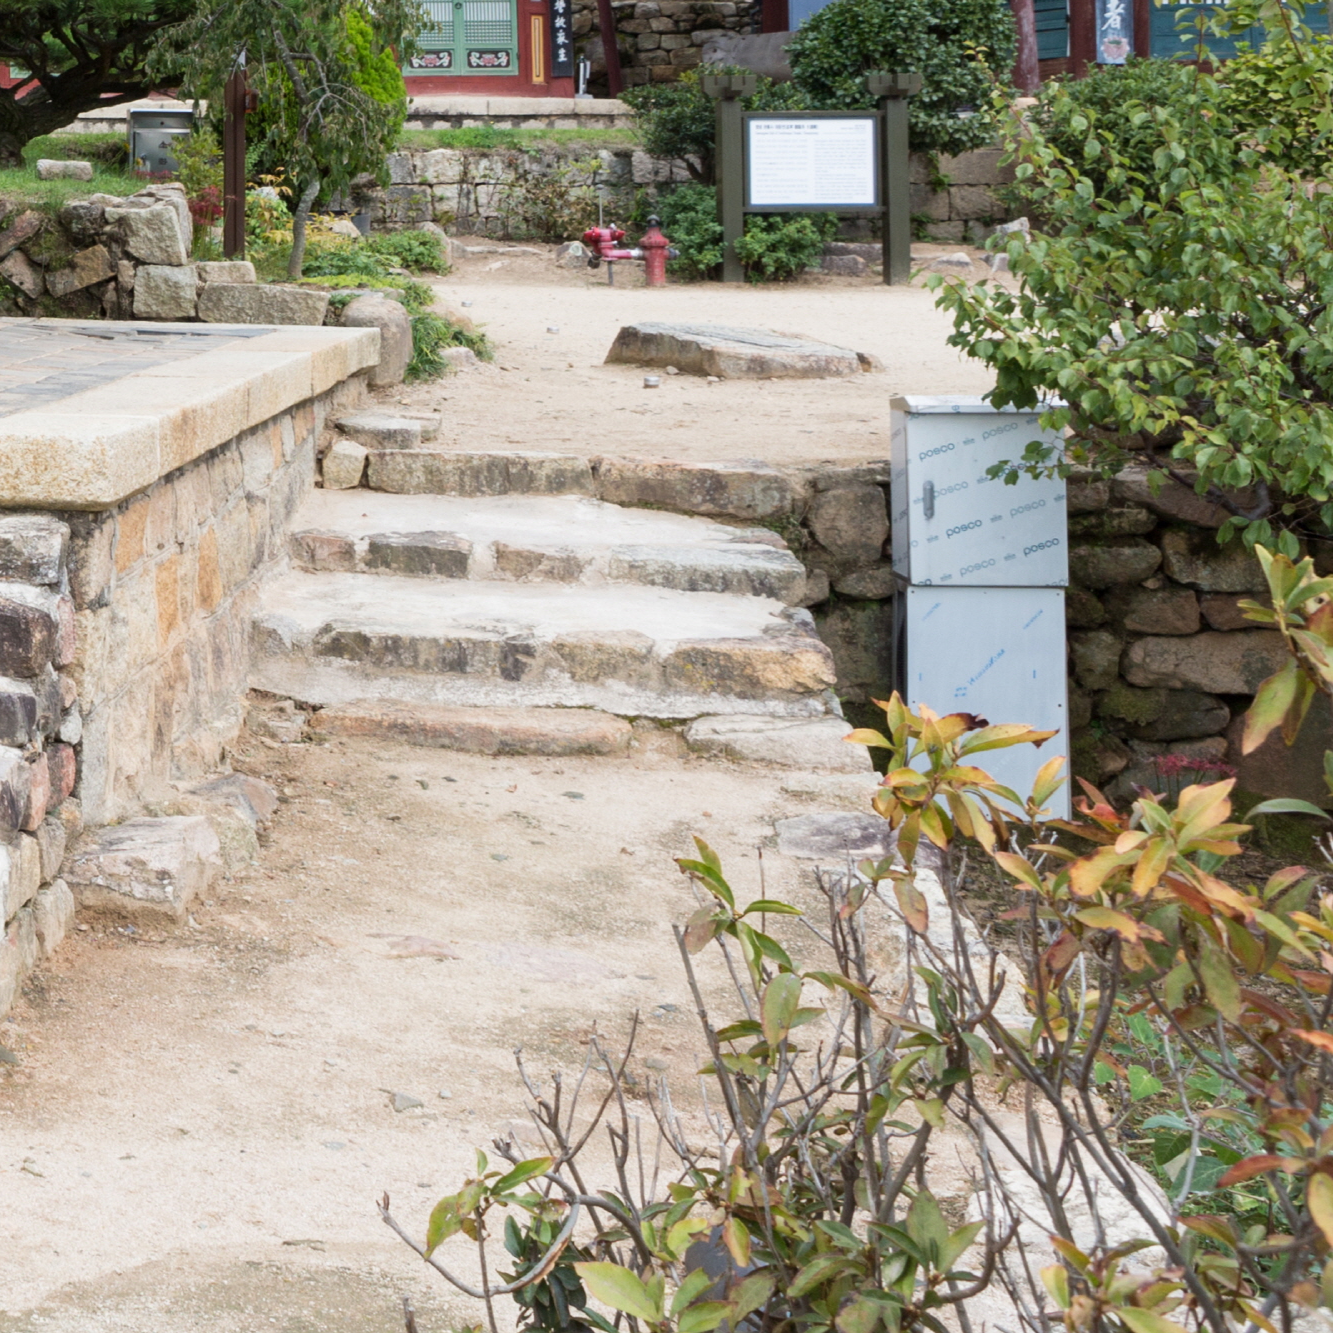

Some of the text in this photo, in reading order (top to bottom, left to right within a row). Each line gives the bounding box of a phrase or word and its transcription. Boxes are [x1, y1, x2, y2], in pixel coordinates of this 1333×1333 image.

[918, 422, 1019, 462] posco posco
[945, 519, 983, 539] posco
[1009, 498, 1047, 519] posco
[959, 557, 996, 578] posco
[1023, 537, 1060, 557] posco
